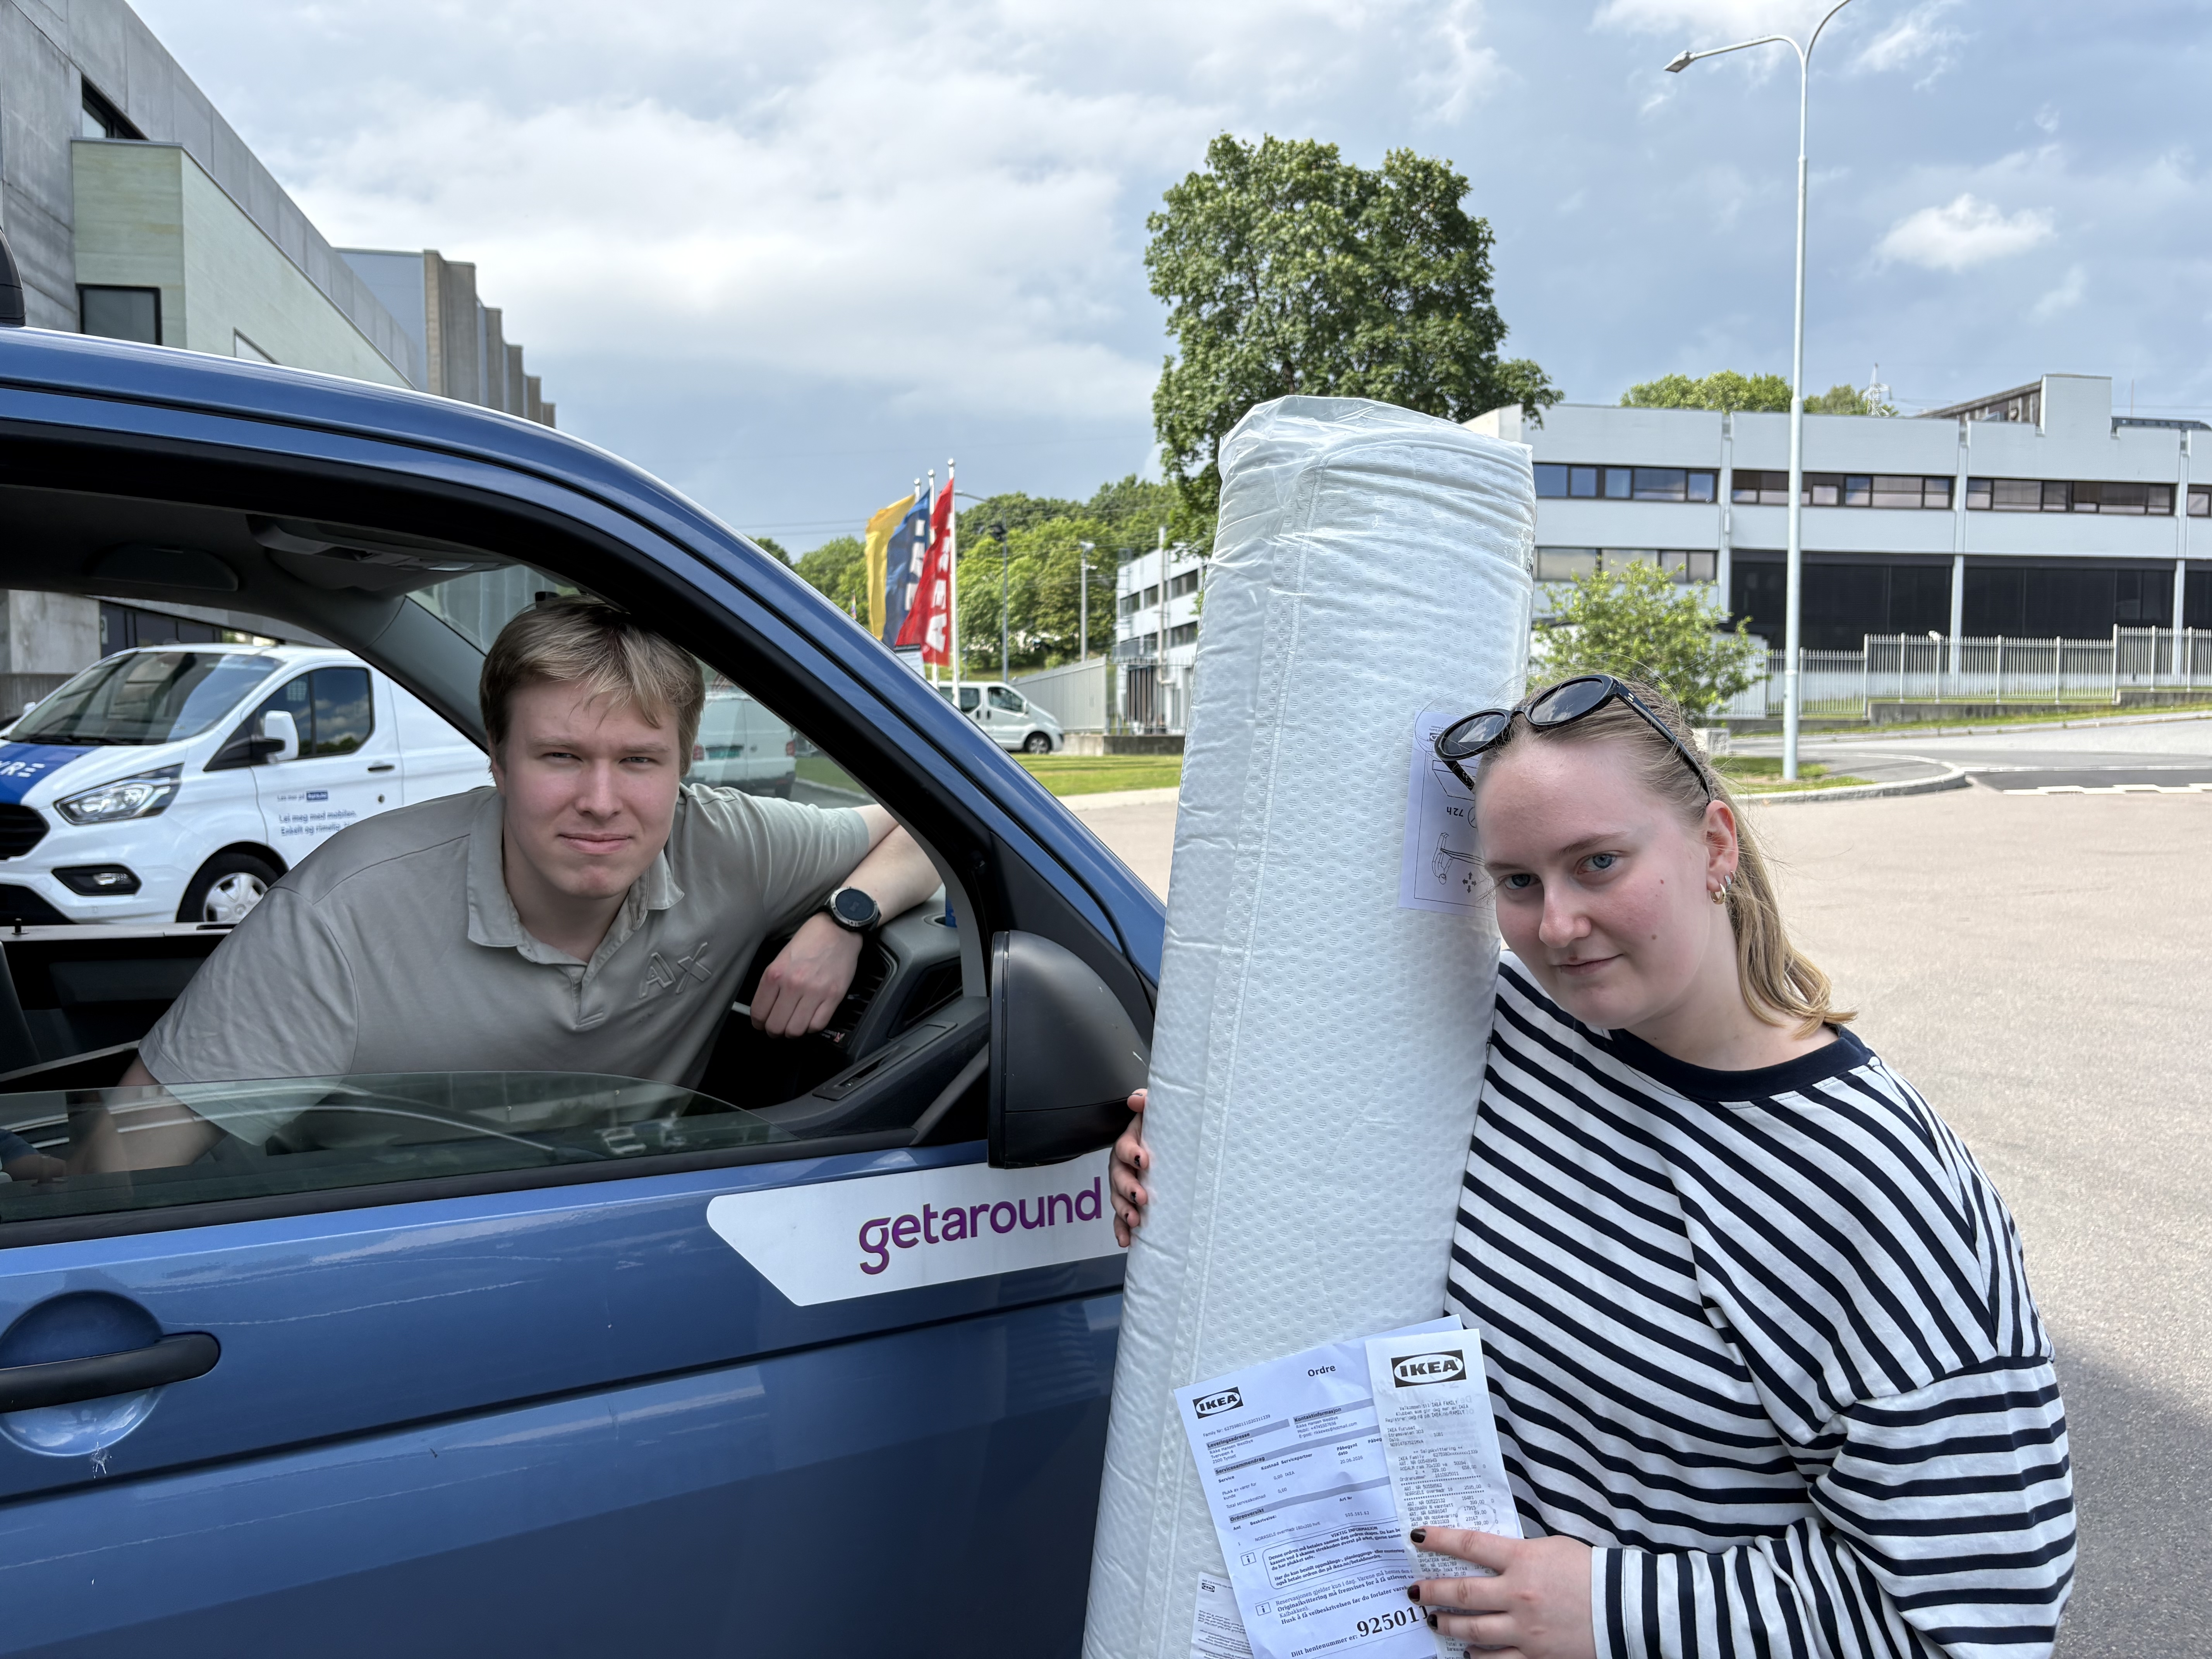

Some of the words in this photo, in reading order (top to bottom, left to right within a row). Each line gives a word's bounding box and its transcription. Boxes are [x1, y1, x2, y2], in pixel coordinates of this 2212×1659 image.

[1446, 806, 1463, 817] 72h
[639, 942, 712, 1000] AX
[859, 1176, 1102, 1275] getaround
[1308, 1365, 1336, 1376] Ordre
[1400, 1359, 1459, 1377] IKEA
[1199, 1394, 1237, 1411] IKEA
[1294, 1408, 1341, 1422] Kontaktinformasjon
[1207, 1433, 1250, 1448] Leveringsadresse
[1216, 1457, 1265, 1474] Servicesammendrag
[1261, 1462, 1279, 1470] Kostnad
[1281, 1454, 1312, 1464] Servicepartner
[1230, 1508, 1264, 1521] Ordreoversikt
[1250, 1515, 1276, 1525] Beskrivelse:
[1255, 1532, 1276, 1541] NORRSELE
[1348, 1523, 1377, 1537] INFORMASJON
[1364, 1528, 1379, 1538] skapes.
[1316, 1543, 1340, 1552] strekkoden
[1287, 1558, 1304, 1566] plukket
[1315, 1559, 1343, 1568] oppmålings-,
[1344, 1551, 1373, 1561] planleggings-
[1333, 1552, 1382, 1569] ikea.no/betaldinordre.
[1276, 1592, 1312, 1606] Reservasjonen
[1313, 1587, 1330, 1595] gjelder
[1384, 1566, 1400, 1577] hentes
[1278, 1595, 1327, 1611] Originalkvittering
[1338, 1583, 1365, 1594] fremvises
[1387, 1571, 1407, 1581] utlevert
[1309, 1601, 1351, 1616] veibeskrivelsen
[1370, 1589, 1391, 1598] forlater
[1279, 1606, 1309, 1618] Kalbakken).
[1305, 1638, 1347, 1653] hentenummer
